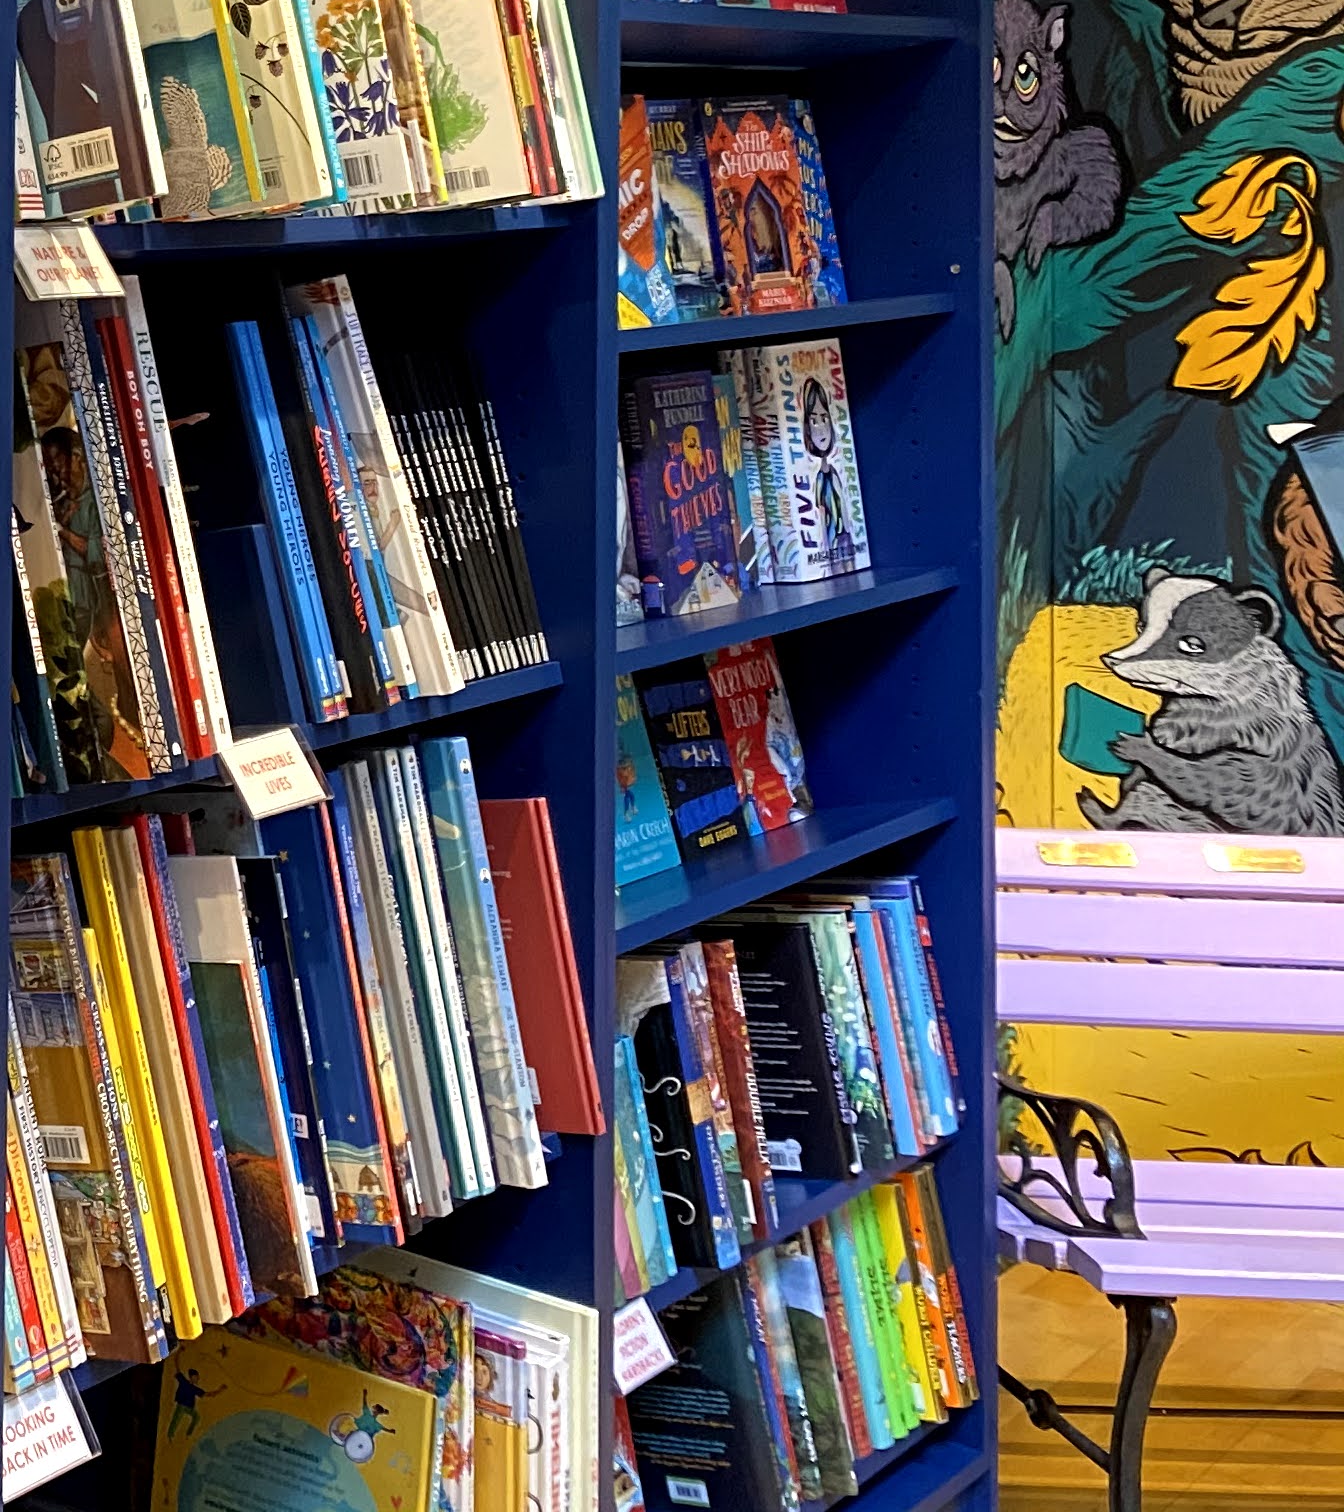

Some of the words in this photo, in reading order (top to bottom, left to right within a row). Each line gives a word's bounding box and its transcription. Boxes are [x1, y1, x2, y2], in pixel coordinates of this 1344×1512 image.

[732, 130, 769, 154] SHIP
[718, 150, 790, 179] SHADOWS
[124, 369, 141, 410] BOY
[134, 328, 167, 436] RESCUE
[132, 413, 147, 433] OH
[776, 354, 804, 465] THINGS
[139, 437, 154, 472] BOY
[826, 346, 844, 401] AVA
[835, 405, 866, 540] ANDREWS
[794, 473, 818, 550] FIVE
[238, 749, 296, 777] INCREDIBLE
[264, 776, 293, 795] LIVES
[34, 1439, 49, 1460] IN
[48, 1423, 77, 1455] TIME
